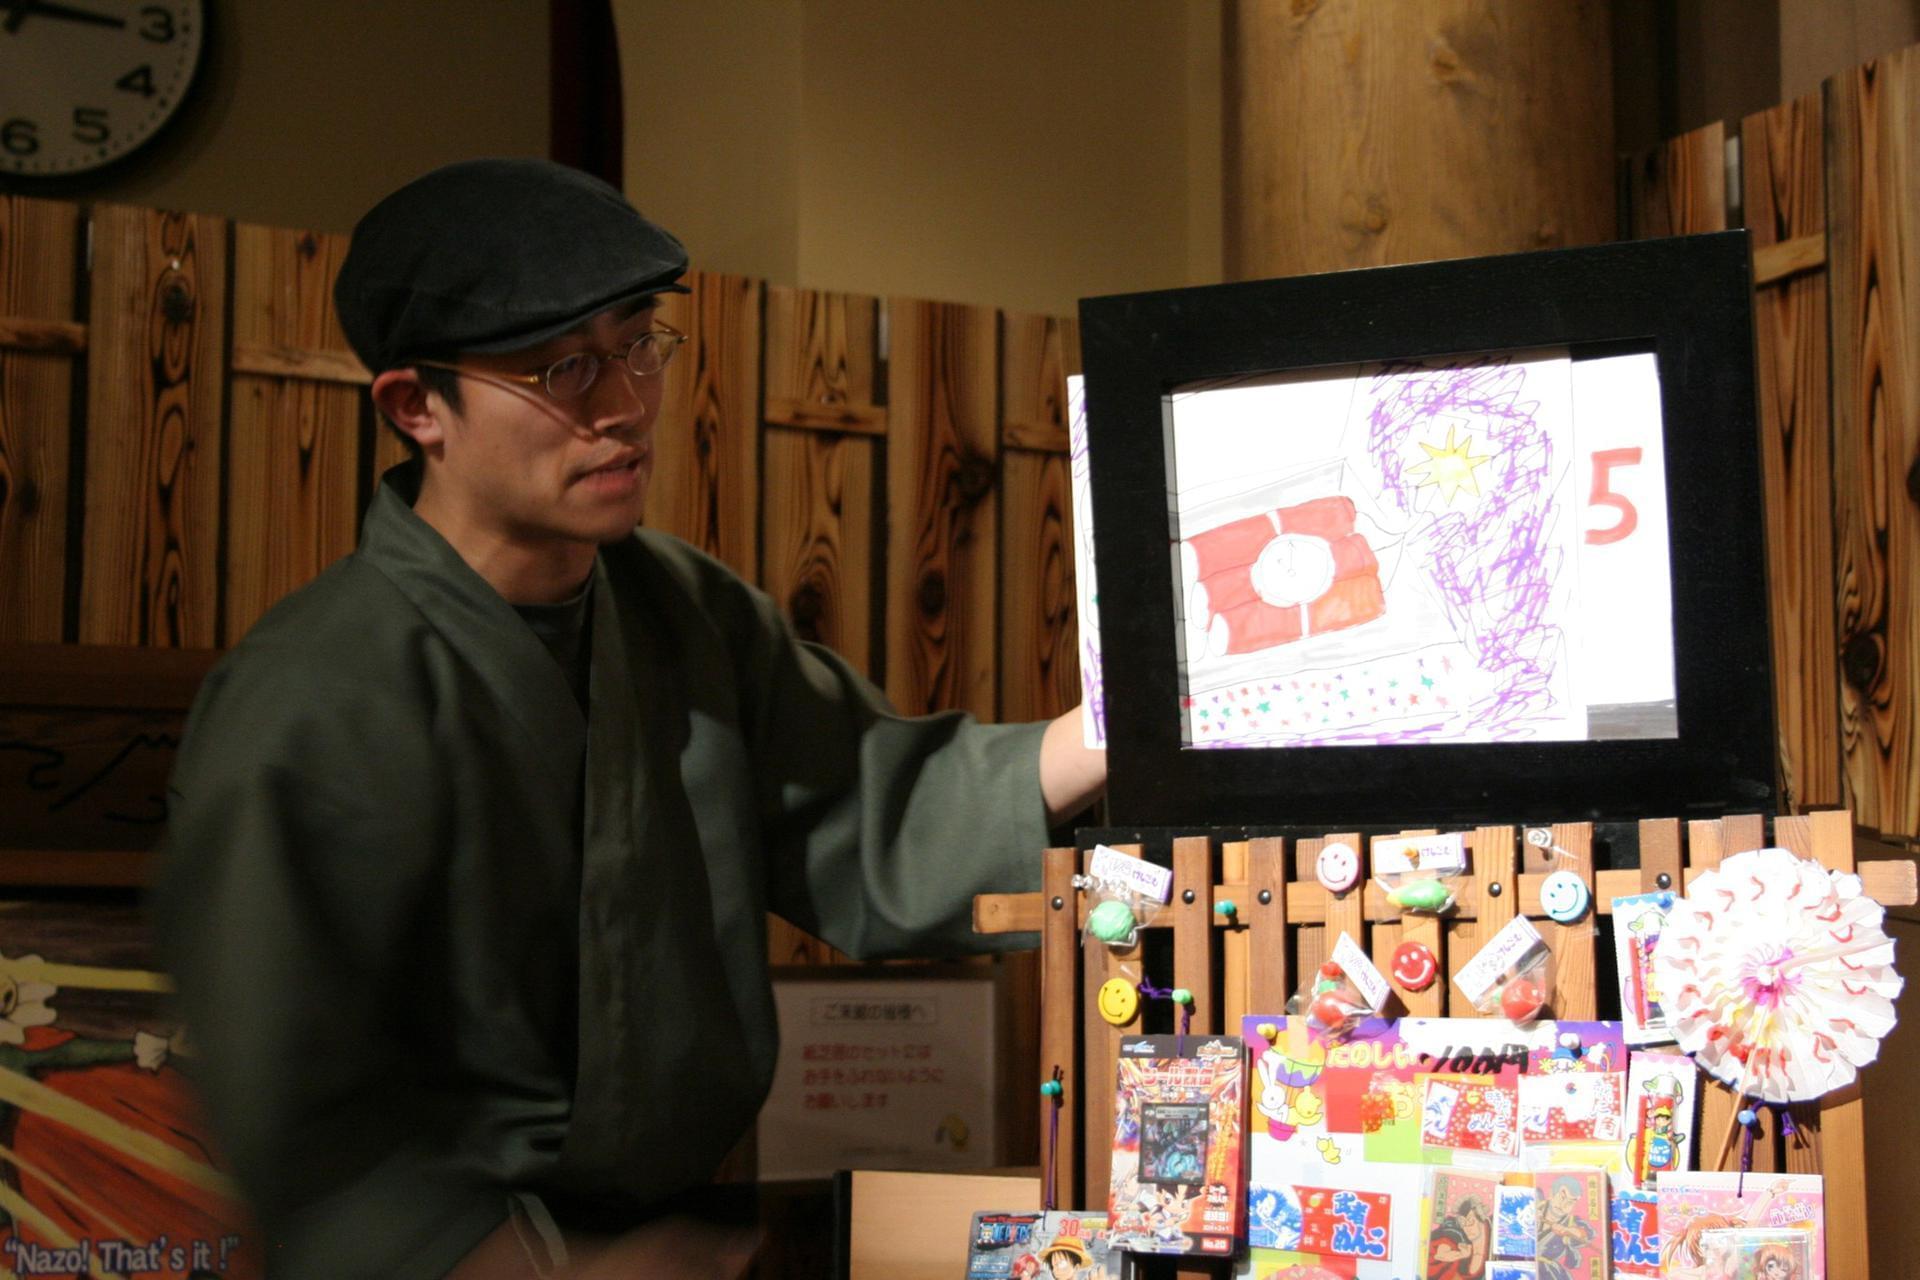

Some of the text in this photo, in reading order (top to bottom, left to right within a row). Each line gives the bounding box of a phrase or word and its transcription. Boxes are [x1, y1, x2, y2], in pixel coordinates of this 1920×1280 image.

[139, 6, 175, 44] 3
[114, 65, 156, 98] 4
[1, 119, 40, 156] 6
[72, 107, 110, 144] 5
[1584, 446, 1644, 546] 5
[1332, 1223, 1385, 1256] めんこ
